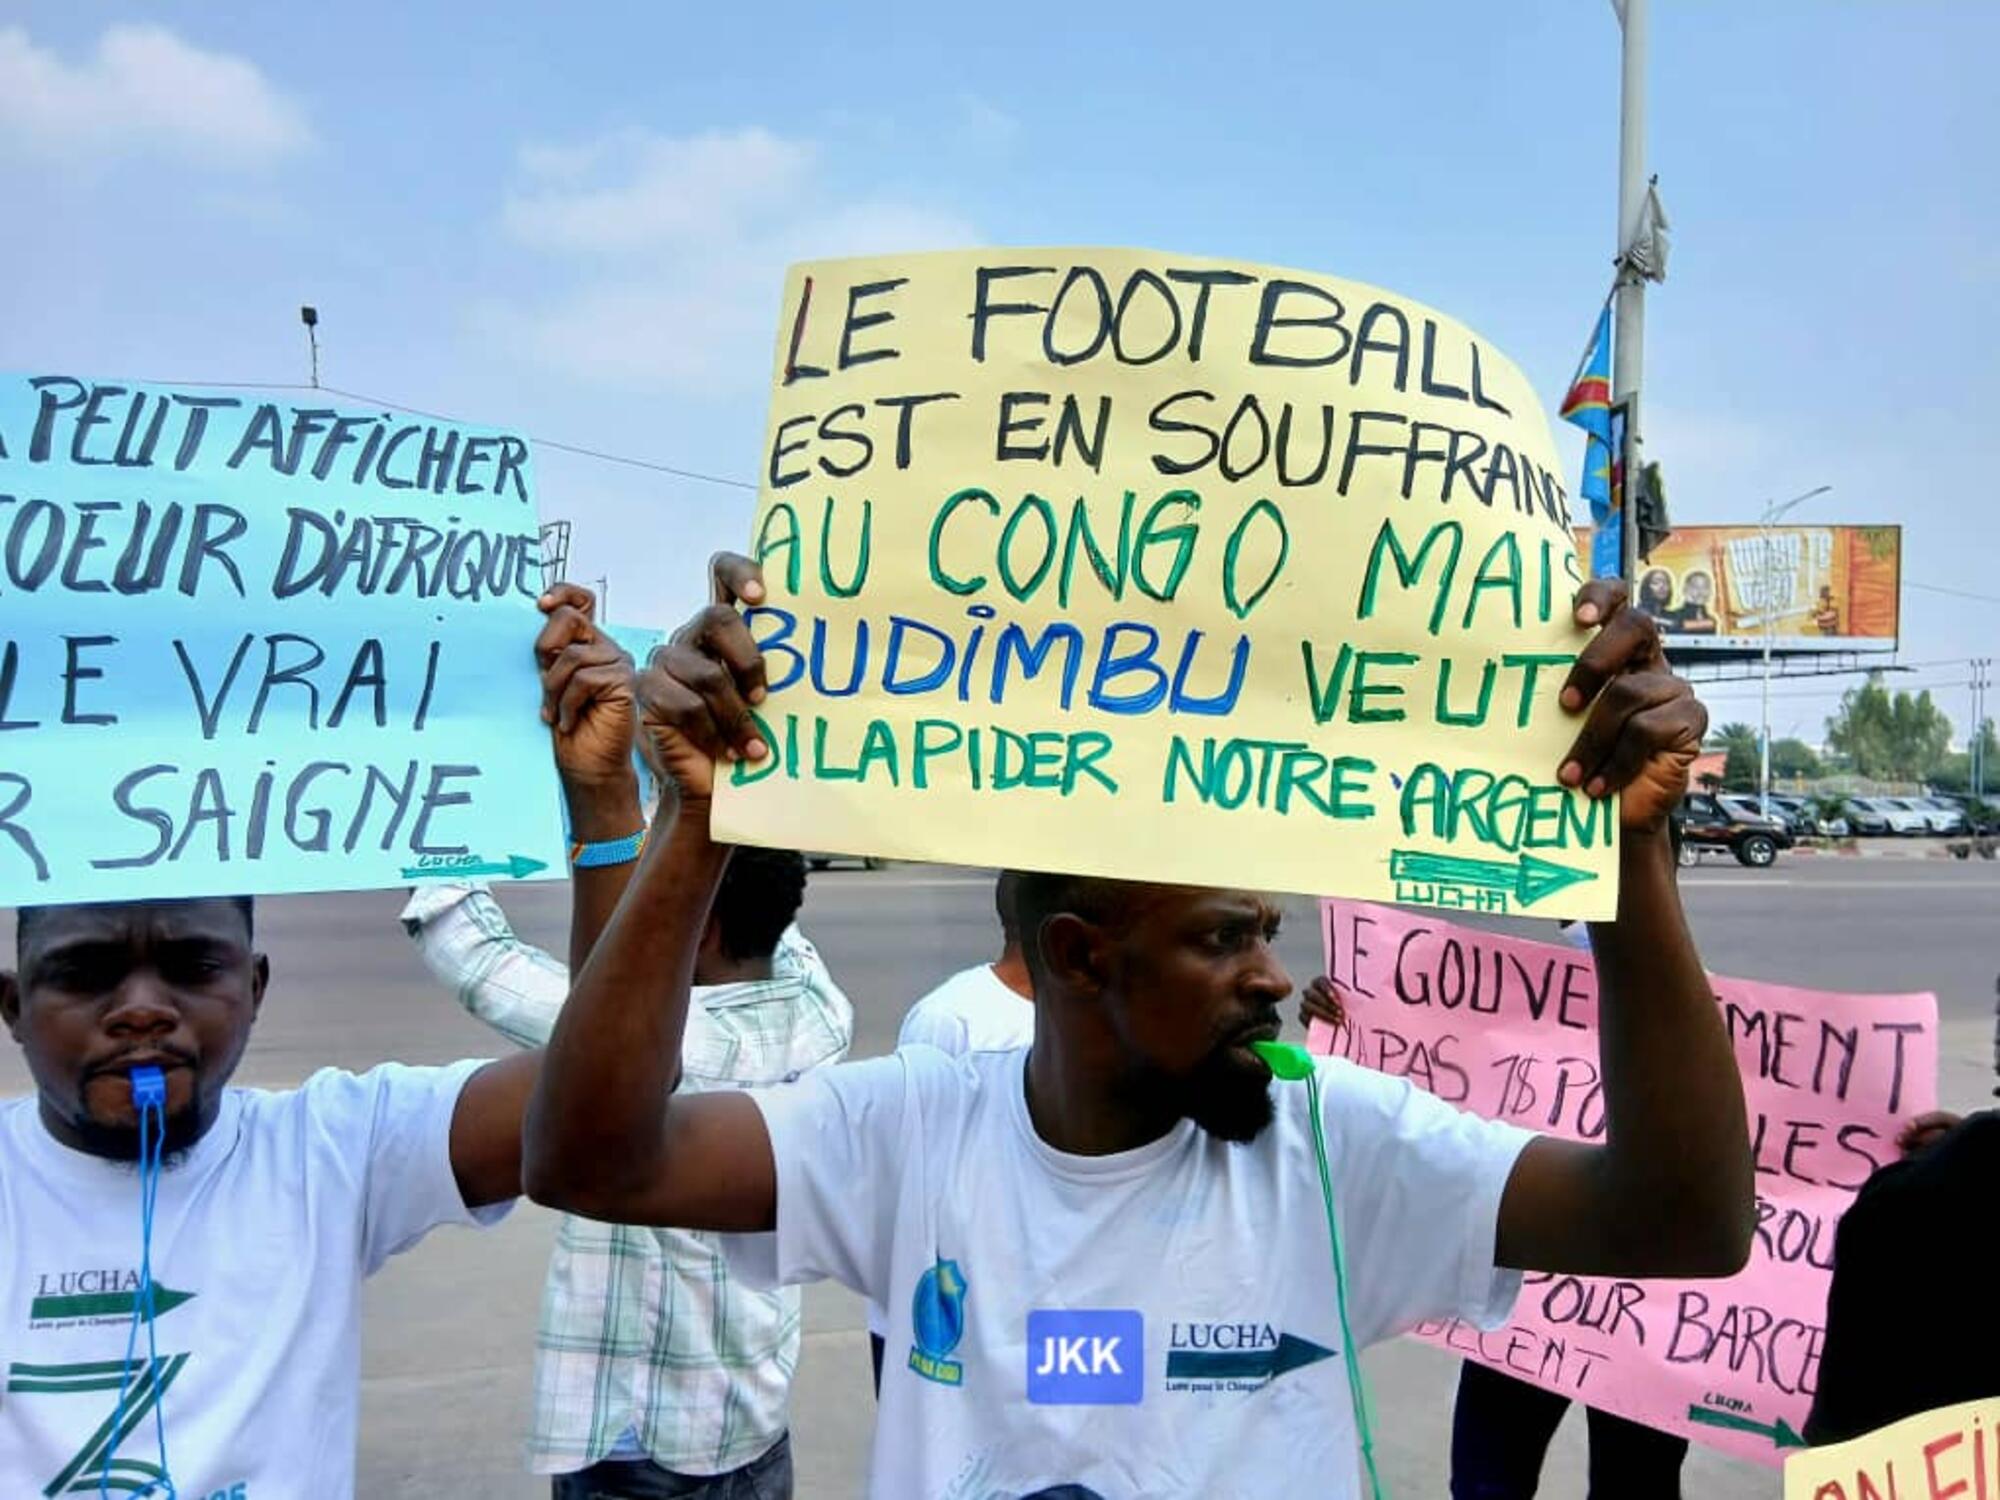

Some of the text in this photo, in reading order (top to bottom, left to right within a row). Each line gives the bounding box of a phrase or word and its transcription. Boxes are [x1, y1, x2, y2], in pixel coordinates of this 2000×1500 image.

[782, 265, 1511, 419] LE FOOTBALL
[28, 375, 530, 503] PEUT AFFICHER
[770, 391, 961, 489] EST
[996, 391, 1112, 474] EN
[0, 494, 249, 598] OEUR
[756, 487, 1584, 635] AU CONGO MAIS
[0, 614, 443, 740] LE VRAI
[742, 604, 1577, 728] BUDIMBU VEUT
[88, 759, 483, 870] SAIGNE
[730, 708, 1119, 796] DILAPIDER
[1163, 736, 1377, 821] NOTRE
[1328, 903, 1377, 999] LE
[1395, 882, 1508, 913] LUCHA
[1371, 1028, 1470, 1103] PAS
[1547, 1056, 1607, 1139] PO
[38, 1269, 142, 1296] LUCHA
[1170, 1321, 1278, 1349] LUCHA
[1524, 1273, 1646, 1347] OUR
